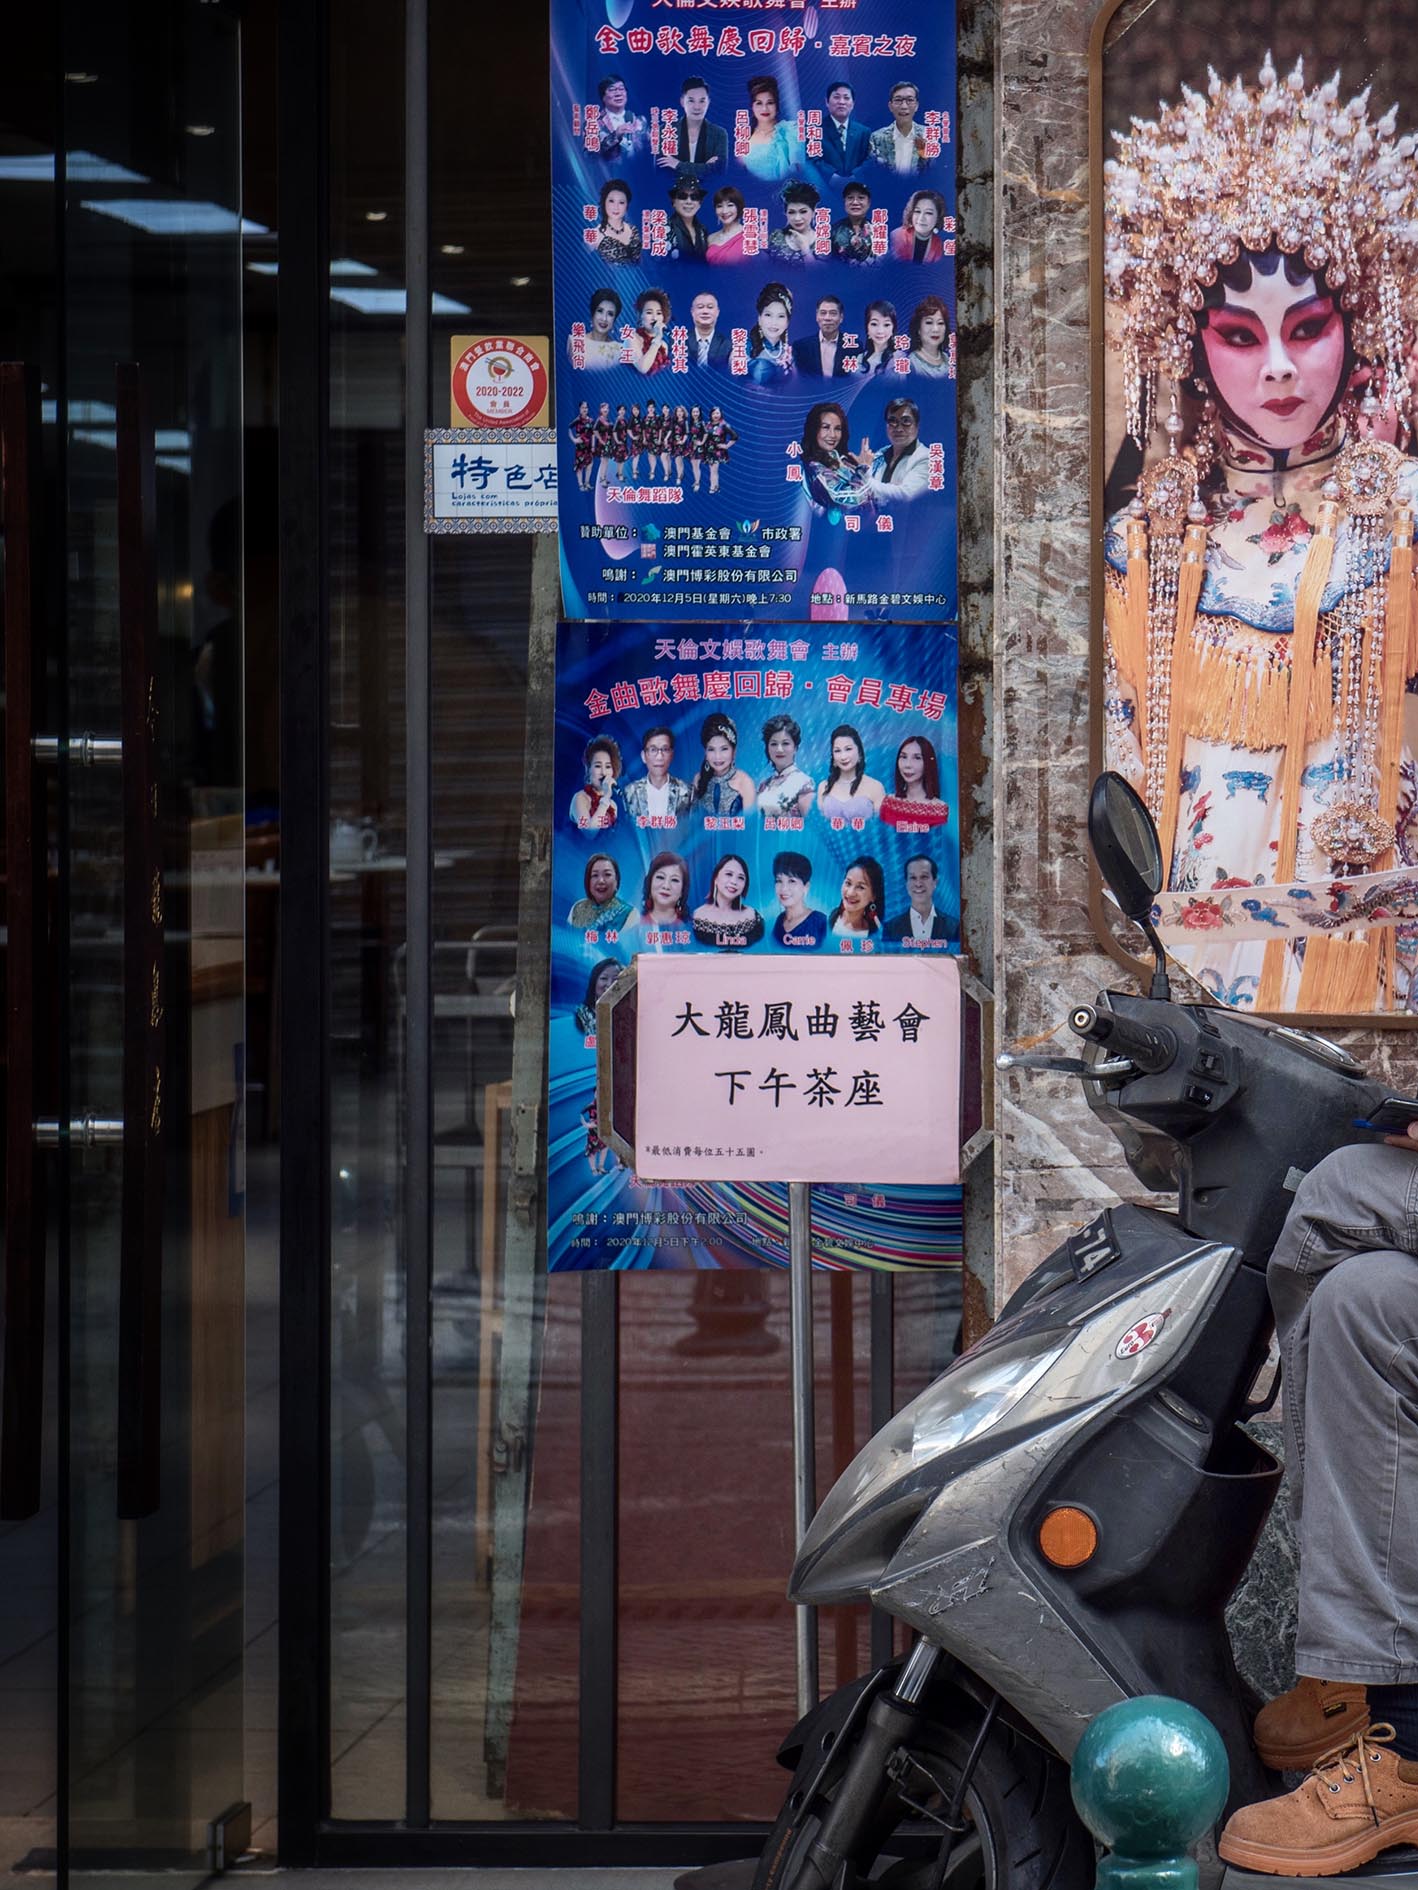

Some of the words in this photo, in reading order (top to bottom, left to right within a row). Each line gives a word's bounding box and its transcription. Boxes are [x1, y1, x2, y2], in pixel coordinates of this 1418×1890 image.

[807, 110, 823, 157] 周和根
[924, 111, 941, 157] 李群勝
[651, 209, 668, 256] 梁偉成
[743, 208, 758, 255] 張雪慧
[620, 324, 635, 365] 女王
[672, 326, 689, 373] 林杜其
[731, 329, 748, 375] 黎玉梨
[843, 332, 860, 373] 江林
[476, 386, 525, 397] 2020-2022
[489, 400, 511, 408] 會員
[451, 453, 558, 490] 特色店
[786, 441, 803, 481] 小鳳
[452, 492, 476, 501] Lojas
[606, 487, 683, 504] 天倫舞蹈隊
[664, 527, 731, 541] 澳門基金會
[762, 528, 802, 541] 市政署
[845, 516, 894, 532] 司儀
[663, 544, 772, 559] 澳門霍英東基金會
[663, 569, 797, 584] 澳門博彩股份有限公司
[654, 639, 810, 661] 天倫文娛歌舞會
[822, 642, 859, 661] 主辦
[636, 816, 677, 829] 李群勝
[704, 817, 745, 830] 黎玉梨
[902, 937, 948, 950] Stephen
[671, 1001, 931, 1043] 大龍鳳曲藝會
[714, 1067, 884, 1108] 下午茶座
